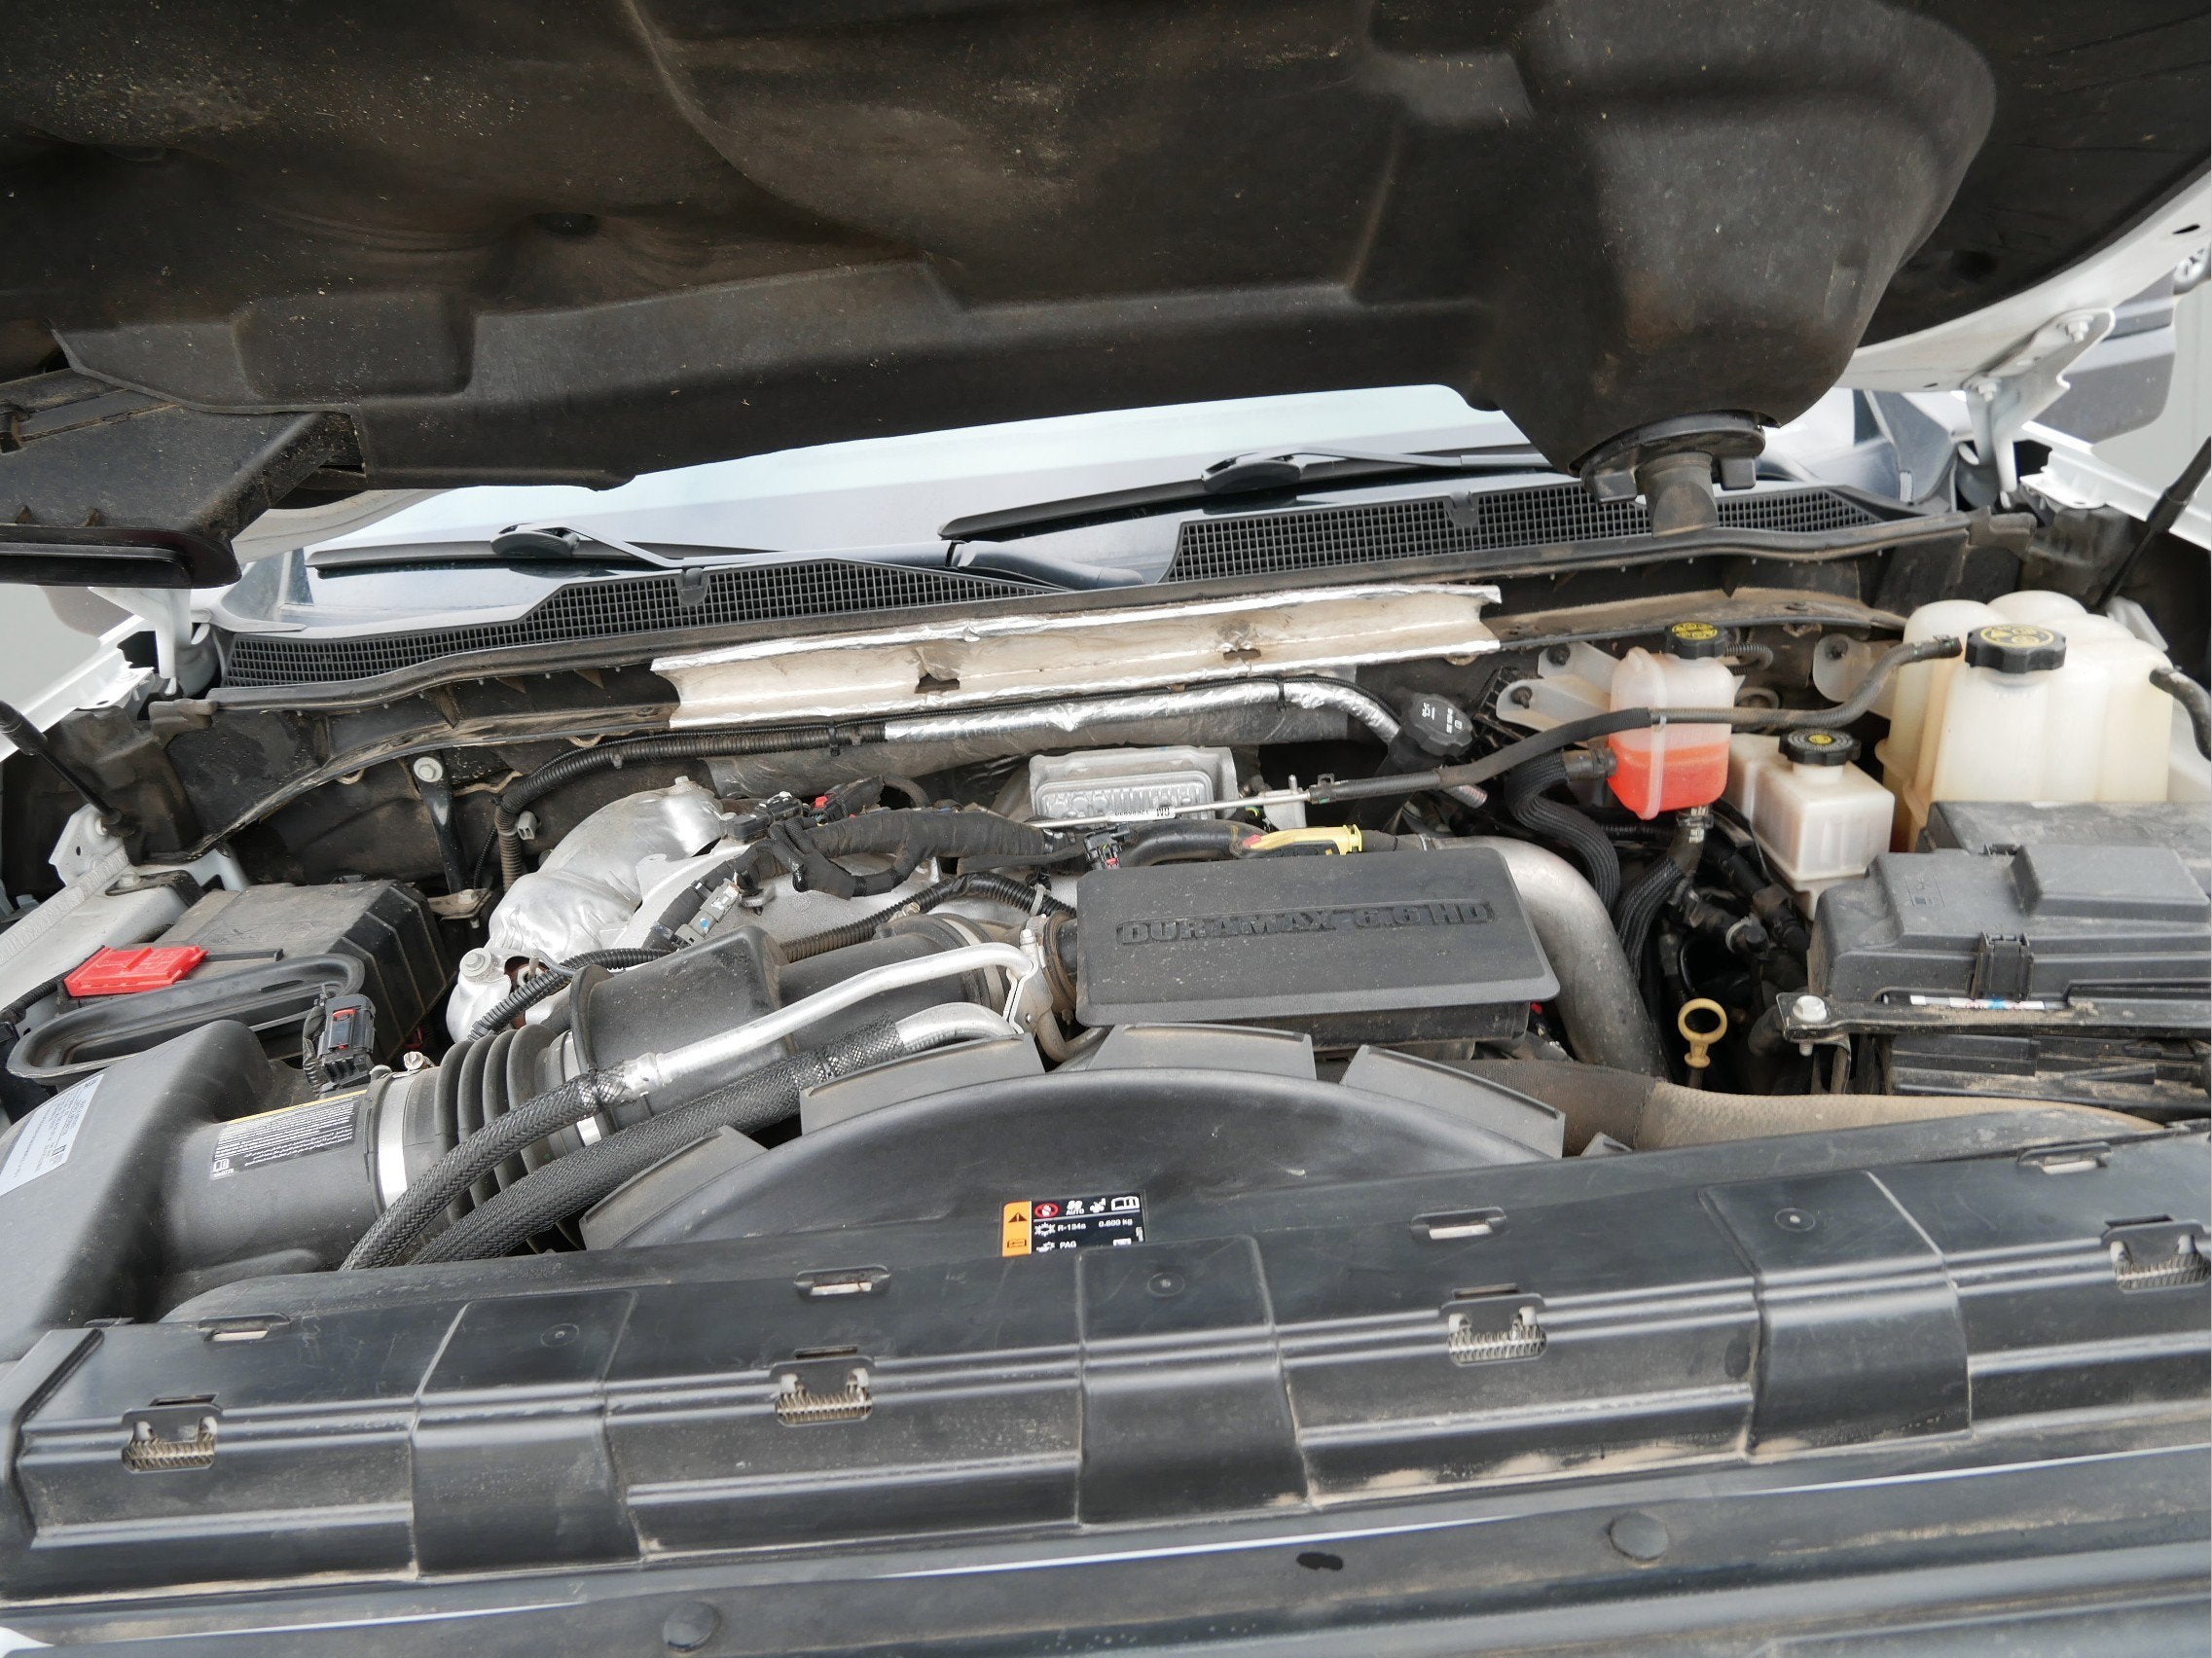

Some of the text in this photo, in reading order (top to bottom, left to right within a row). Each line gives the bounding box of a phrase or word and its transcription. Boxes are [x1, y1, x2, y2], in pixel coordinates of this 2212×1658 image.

[1122, 911, 1336, 944] DURAMAX
[1430, 902, 1489, 924] HD
[1066, 1207, 1085, 1216] AUTO
[1059, 1240, 1077, 1249] PAG
